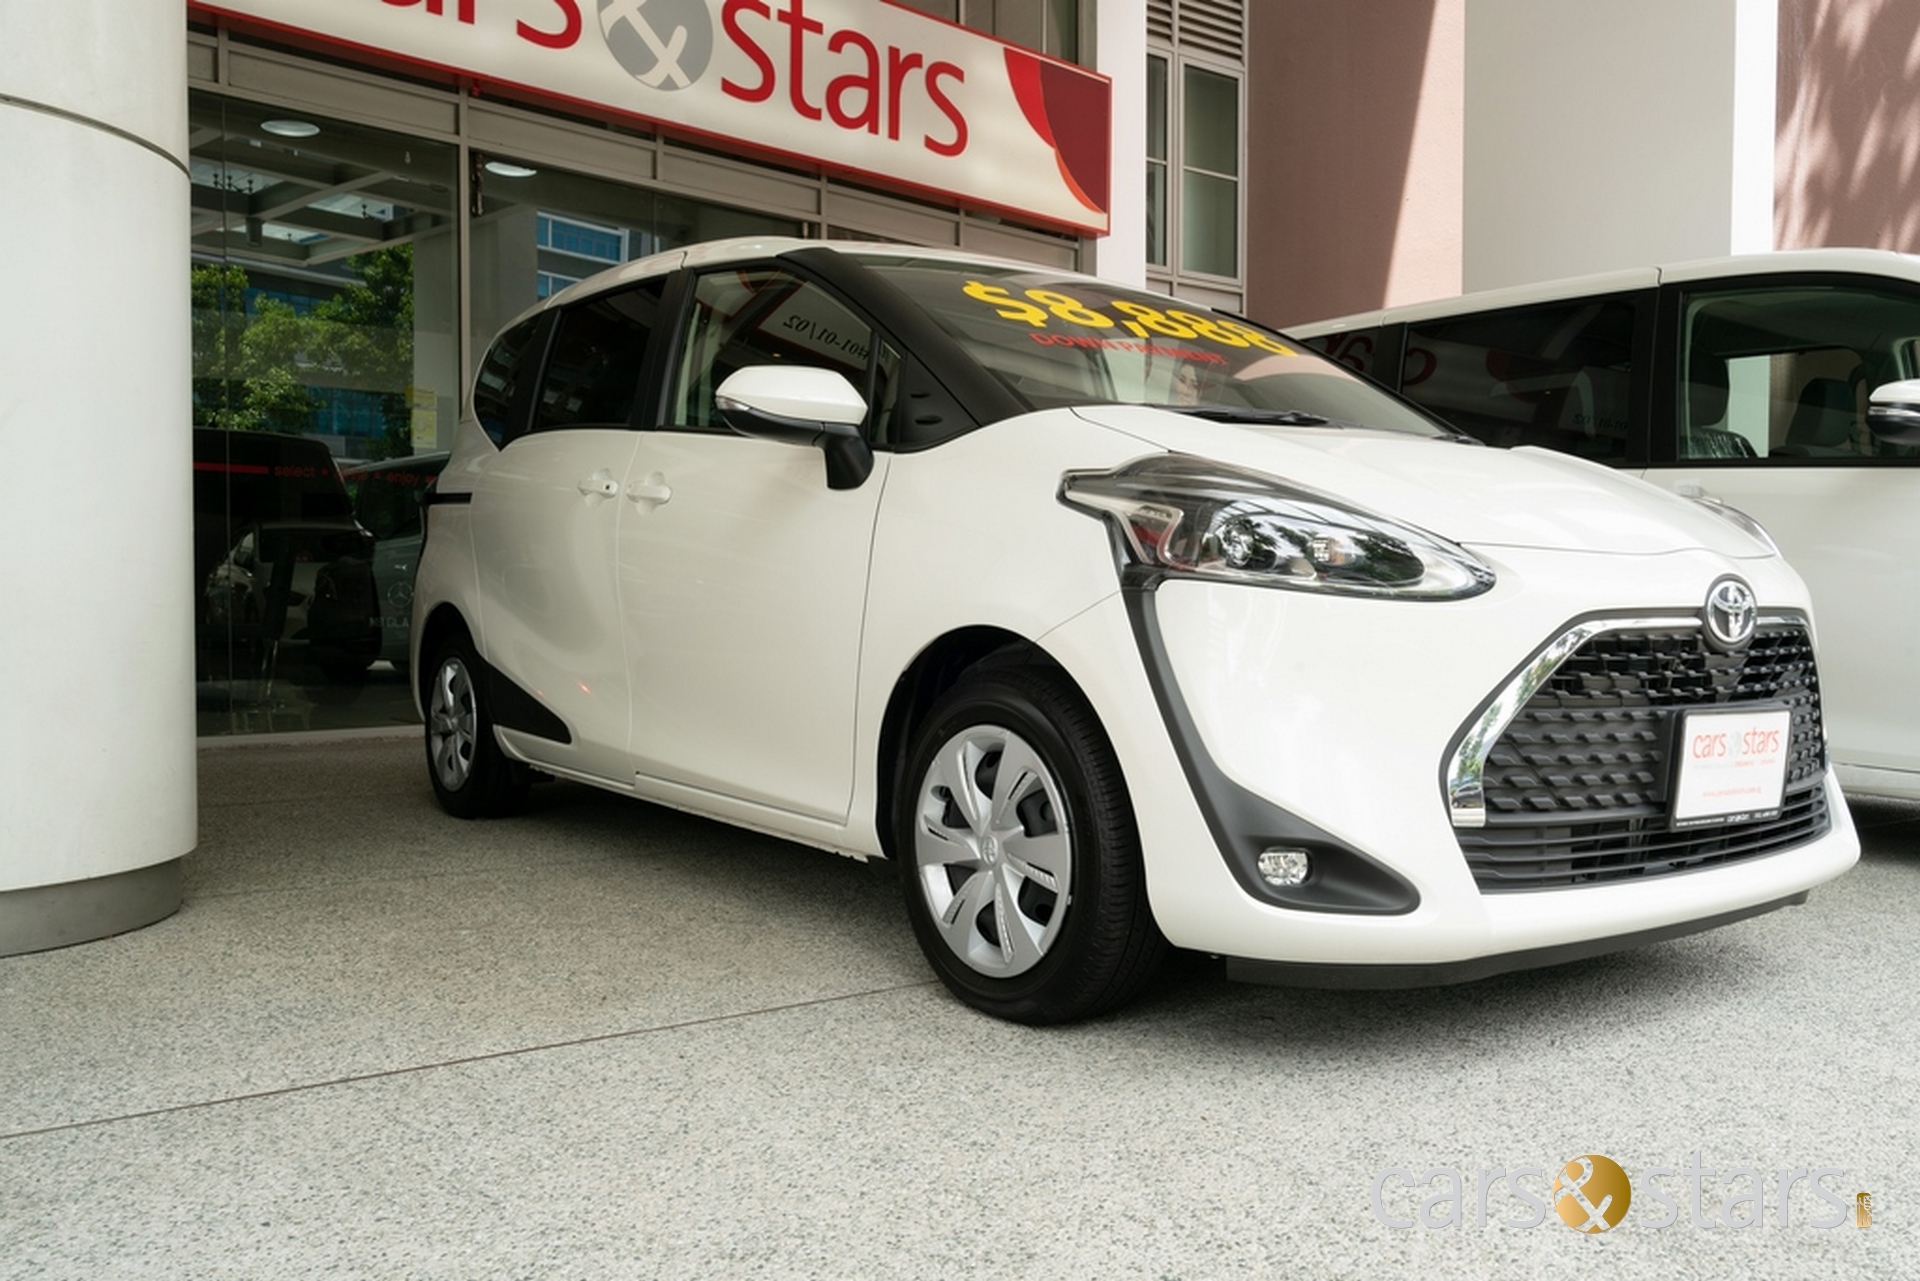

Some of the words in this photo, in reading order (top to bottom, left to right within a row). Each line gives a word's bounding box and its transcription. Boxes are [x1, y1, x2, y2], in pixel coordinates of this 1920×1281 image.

[721, 0, 968, 157] stars
[962, 281, 1298, 357] $8,888
[1029, 333, 1118, 350] DOWN
[1120, 341, 1228, 365] PAYMENT
[273, 464, 316, 478] select
[386, 470, 420, 487] enjoy
[1692, 733, 1727, 758] cars
[1742, 726, 1780, 756] stars
